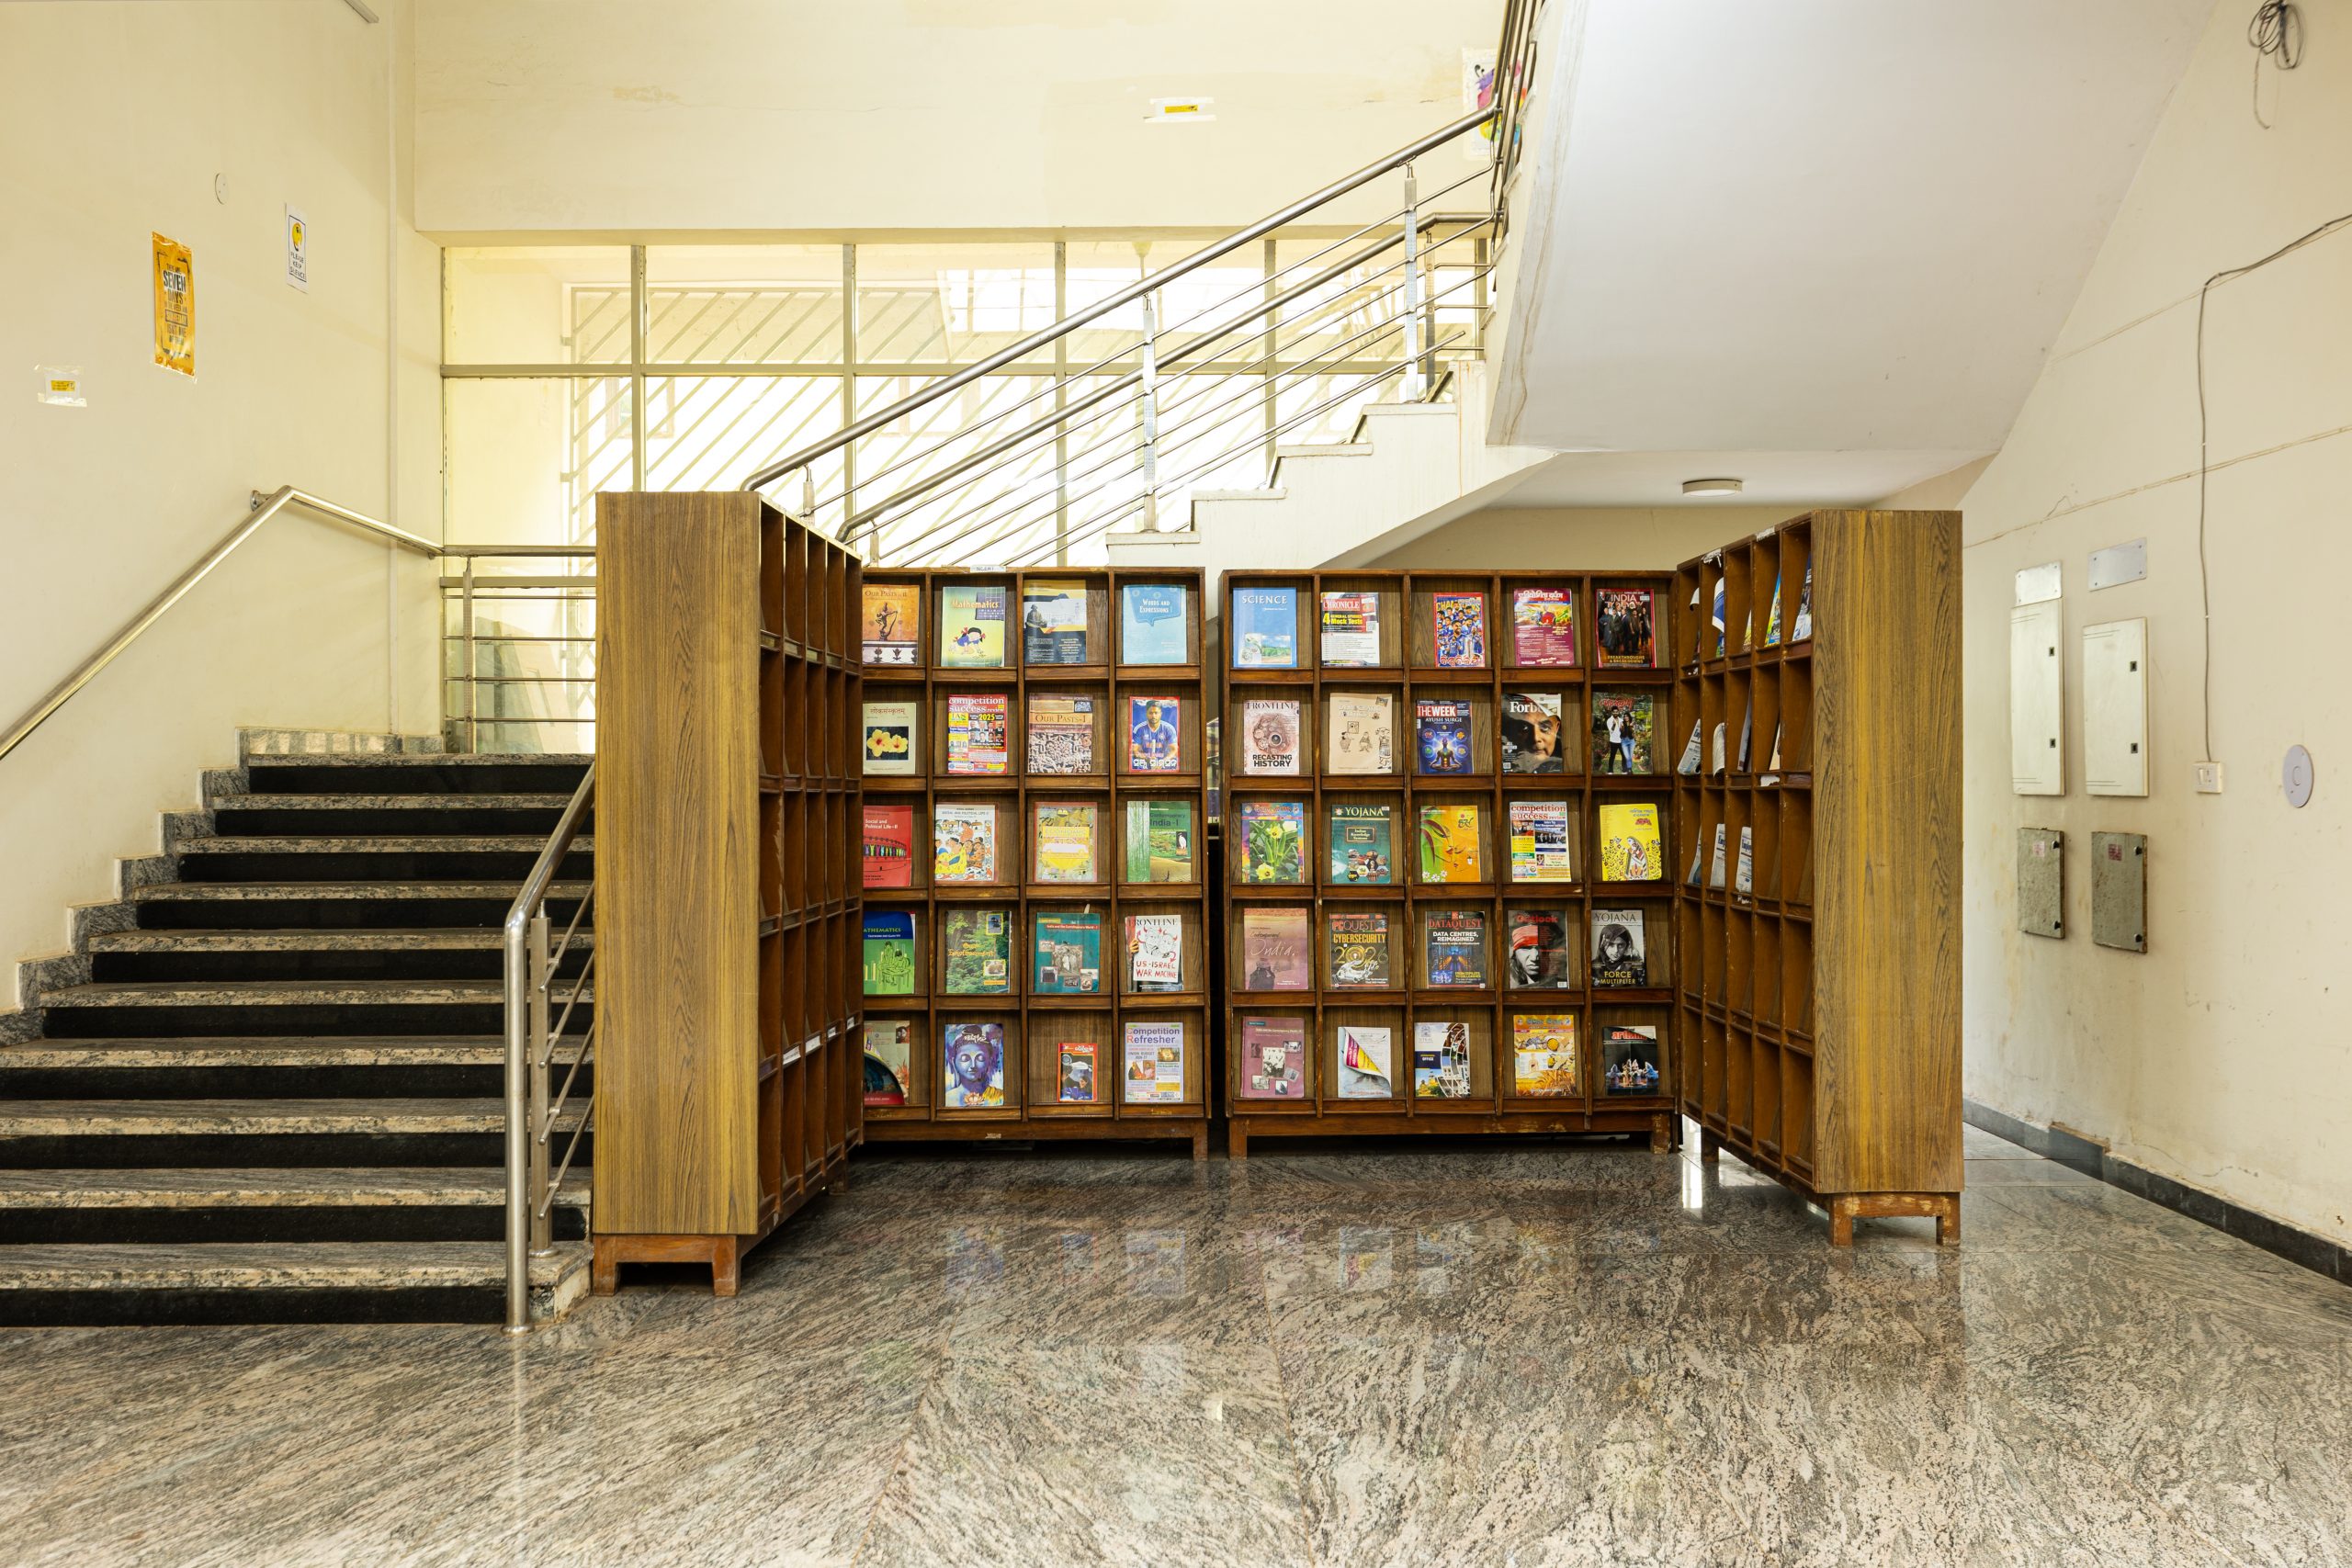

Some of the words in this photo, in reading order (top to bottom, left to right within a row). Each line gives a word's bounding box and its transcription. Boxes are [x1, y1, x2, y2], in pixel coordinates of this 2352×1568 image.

[163, 270, 186, 292] SEVEN
[1242, 595, 1288, 604] SCIENCE
[1611, 593, 1636, 603] INDIA
[952, 599, 999, 609] Mathematics
[1323, 599, 1360, 610] CHRONICLE
[1323, 613, 1330, 625] 4
[1418, 705, 1431, 717] THE
[1431, 705, 1457, 717] WEEK
[1035, 714, 1055, 723] OUR
[1345, 807, 1384, 818] YOJANA
[1510, 805, 1566, 814] competition
[1512, 812, 1549, 820] success
[1516, 915, 1558, 923] Outlook
[1595, 913, 1635, 922] YOJANA
[1429, 919, 1481, 930] DATAQUEST
[1334, 933, 1385, 943] CYBERSECURITY
[1136, 969, 1152, 977] WAR
[1154, 970, 1177, 978] MACHINE
[1126, 1027, 1180, 1036] Competition
[1126, 1035, 1176, 1043] Refresher
